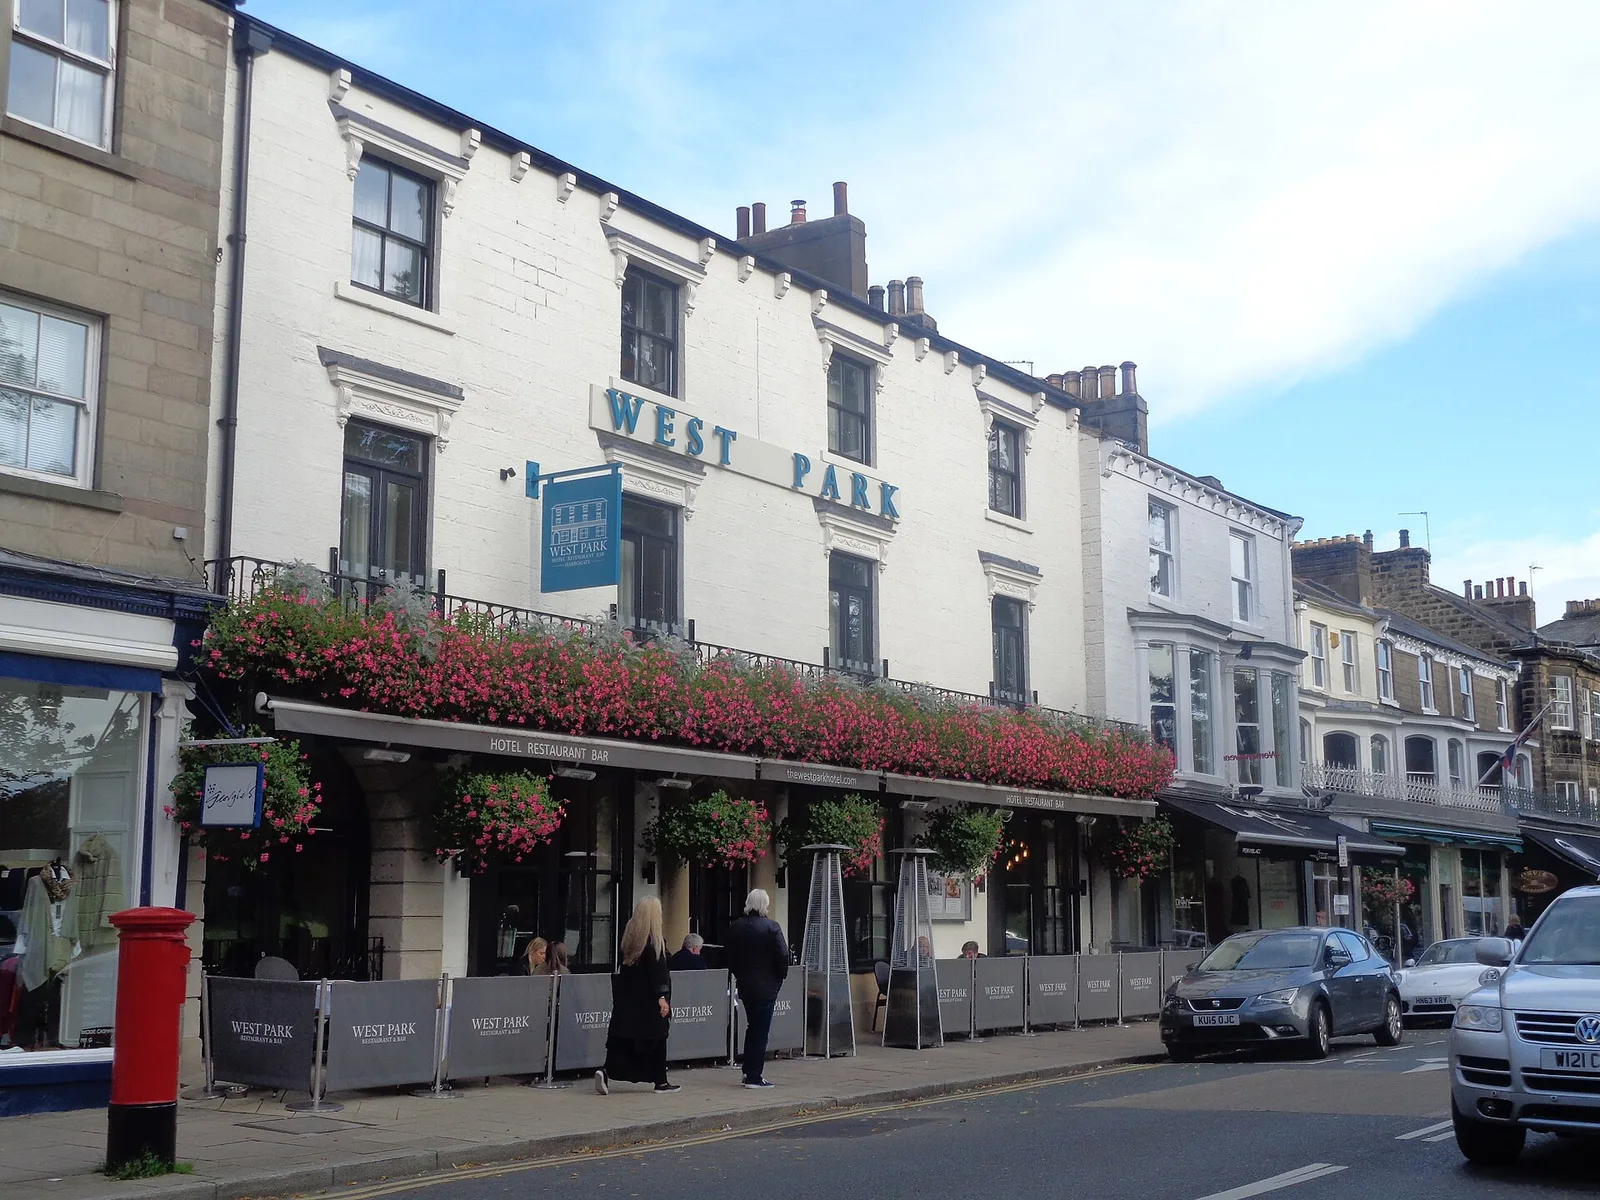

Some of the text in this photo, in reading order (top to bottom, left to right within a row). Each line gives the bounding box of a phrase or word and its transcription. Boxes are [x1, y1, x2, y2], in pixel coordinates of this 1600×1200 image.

[607, 387, 900, 519] WEST PARK
[550, 540, 608, 557] WEST PARK
[490, 738, 609, 762] HOTEL RESTAURANT BAR
[786, 768, 857, 786] thewestparkhotel.com
[1006, 794, 1065, 809] HOTEL RESTAURANT BAR
[939, 988, 968, 998] EST PARK
[984, 985, 1015, 996] WEST PARK
[1039, 982, 1067, 992] WEST PARK
[575, 1012, 603, 1024] WEST
[691, 1005, 713, 1017] PARK
[471, 1015, 530, 1030] WEST PARK
[1198, 1015, 1235, 1025] KU15 OJC
[231, 1020, 293, 1039] WEST PARK
[352, 1022, 416, 1037] WEST PARK
[1555, 1051, 1586, 1068] W121
